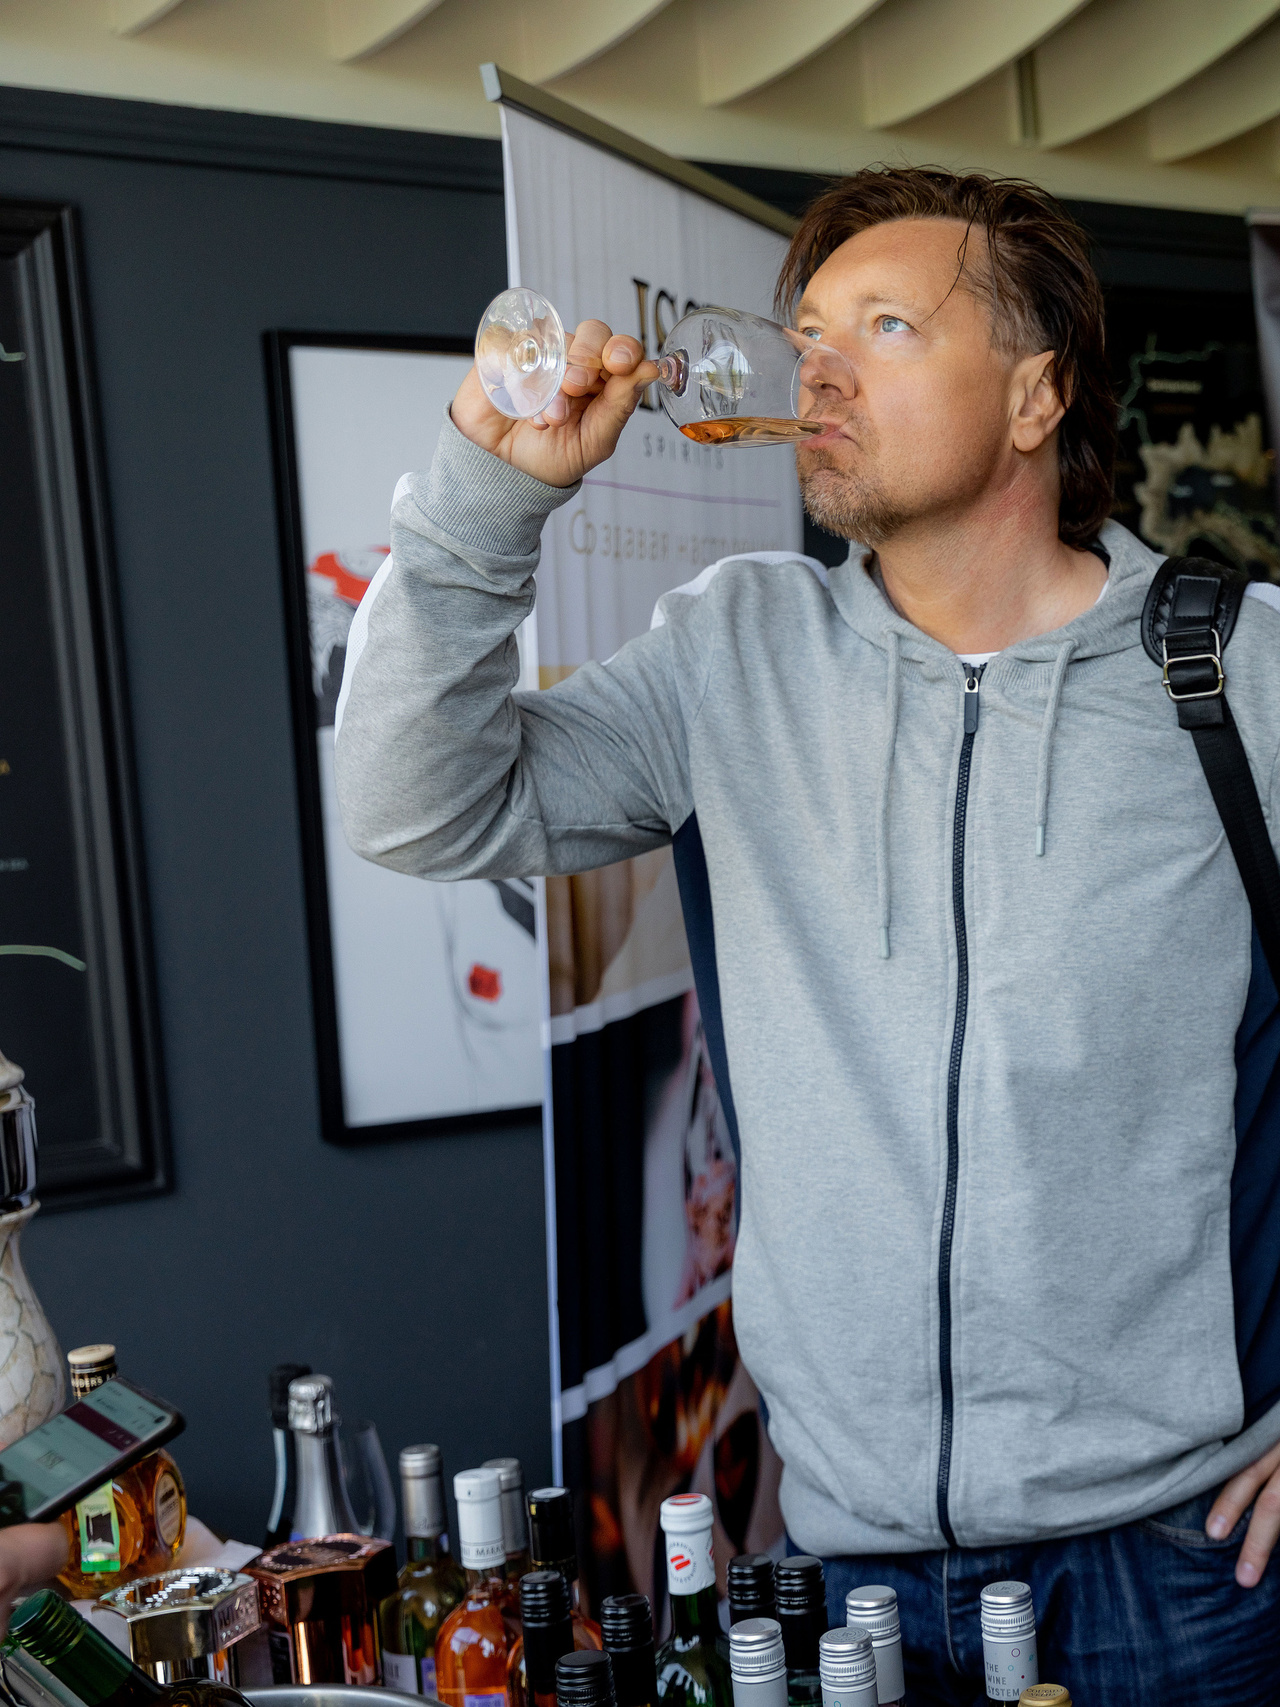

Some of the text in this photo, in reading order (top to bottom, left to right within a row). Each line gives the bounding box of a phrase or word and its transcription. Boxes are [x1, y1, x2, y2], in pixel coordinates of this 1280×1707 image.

[986, 1661, 999, 1673] THE
[987, 1673, 1007, 1686] WINE
[988, 1685, 1020, 1698] SYSTEM
